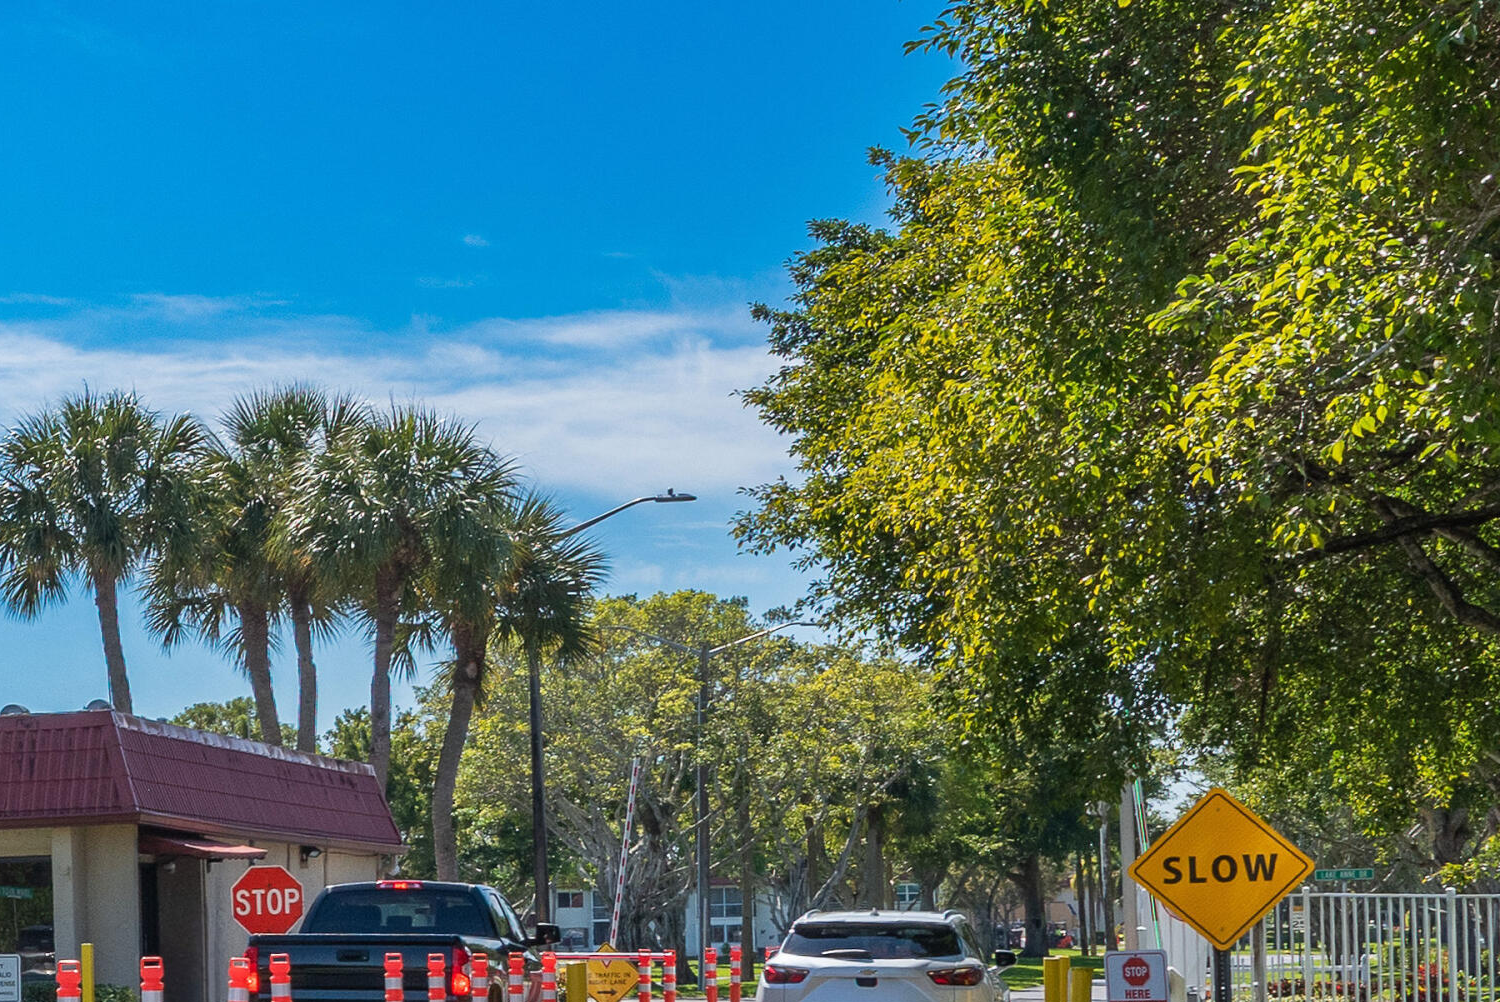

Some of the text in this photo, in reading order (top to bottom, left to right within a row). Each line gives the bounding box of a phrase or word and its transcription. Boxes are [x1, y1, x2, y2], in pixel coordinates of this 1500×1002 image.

[1162, 853, 1278, 884] SLOW
[236, 888, 300, 916] STOP
[1124, 966, 1148, 977] STOP
[1124, 989, 1151, 999] HERE
